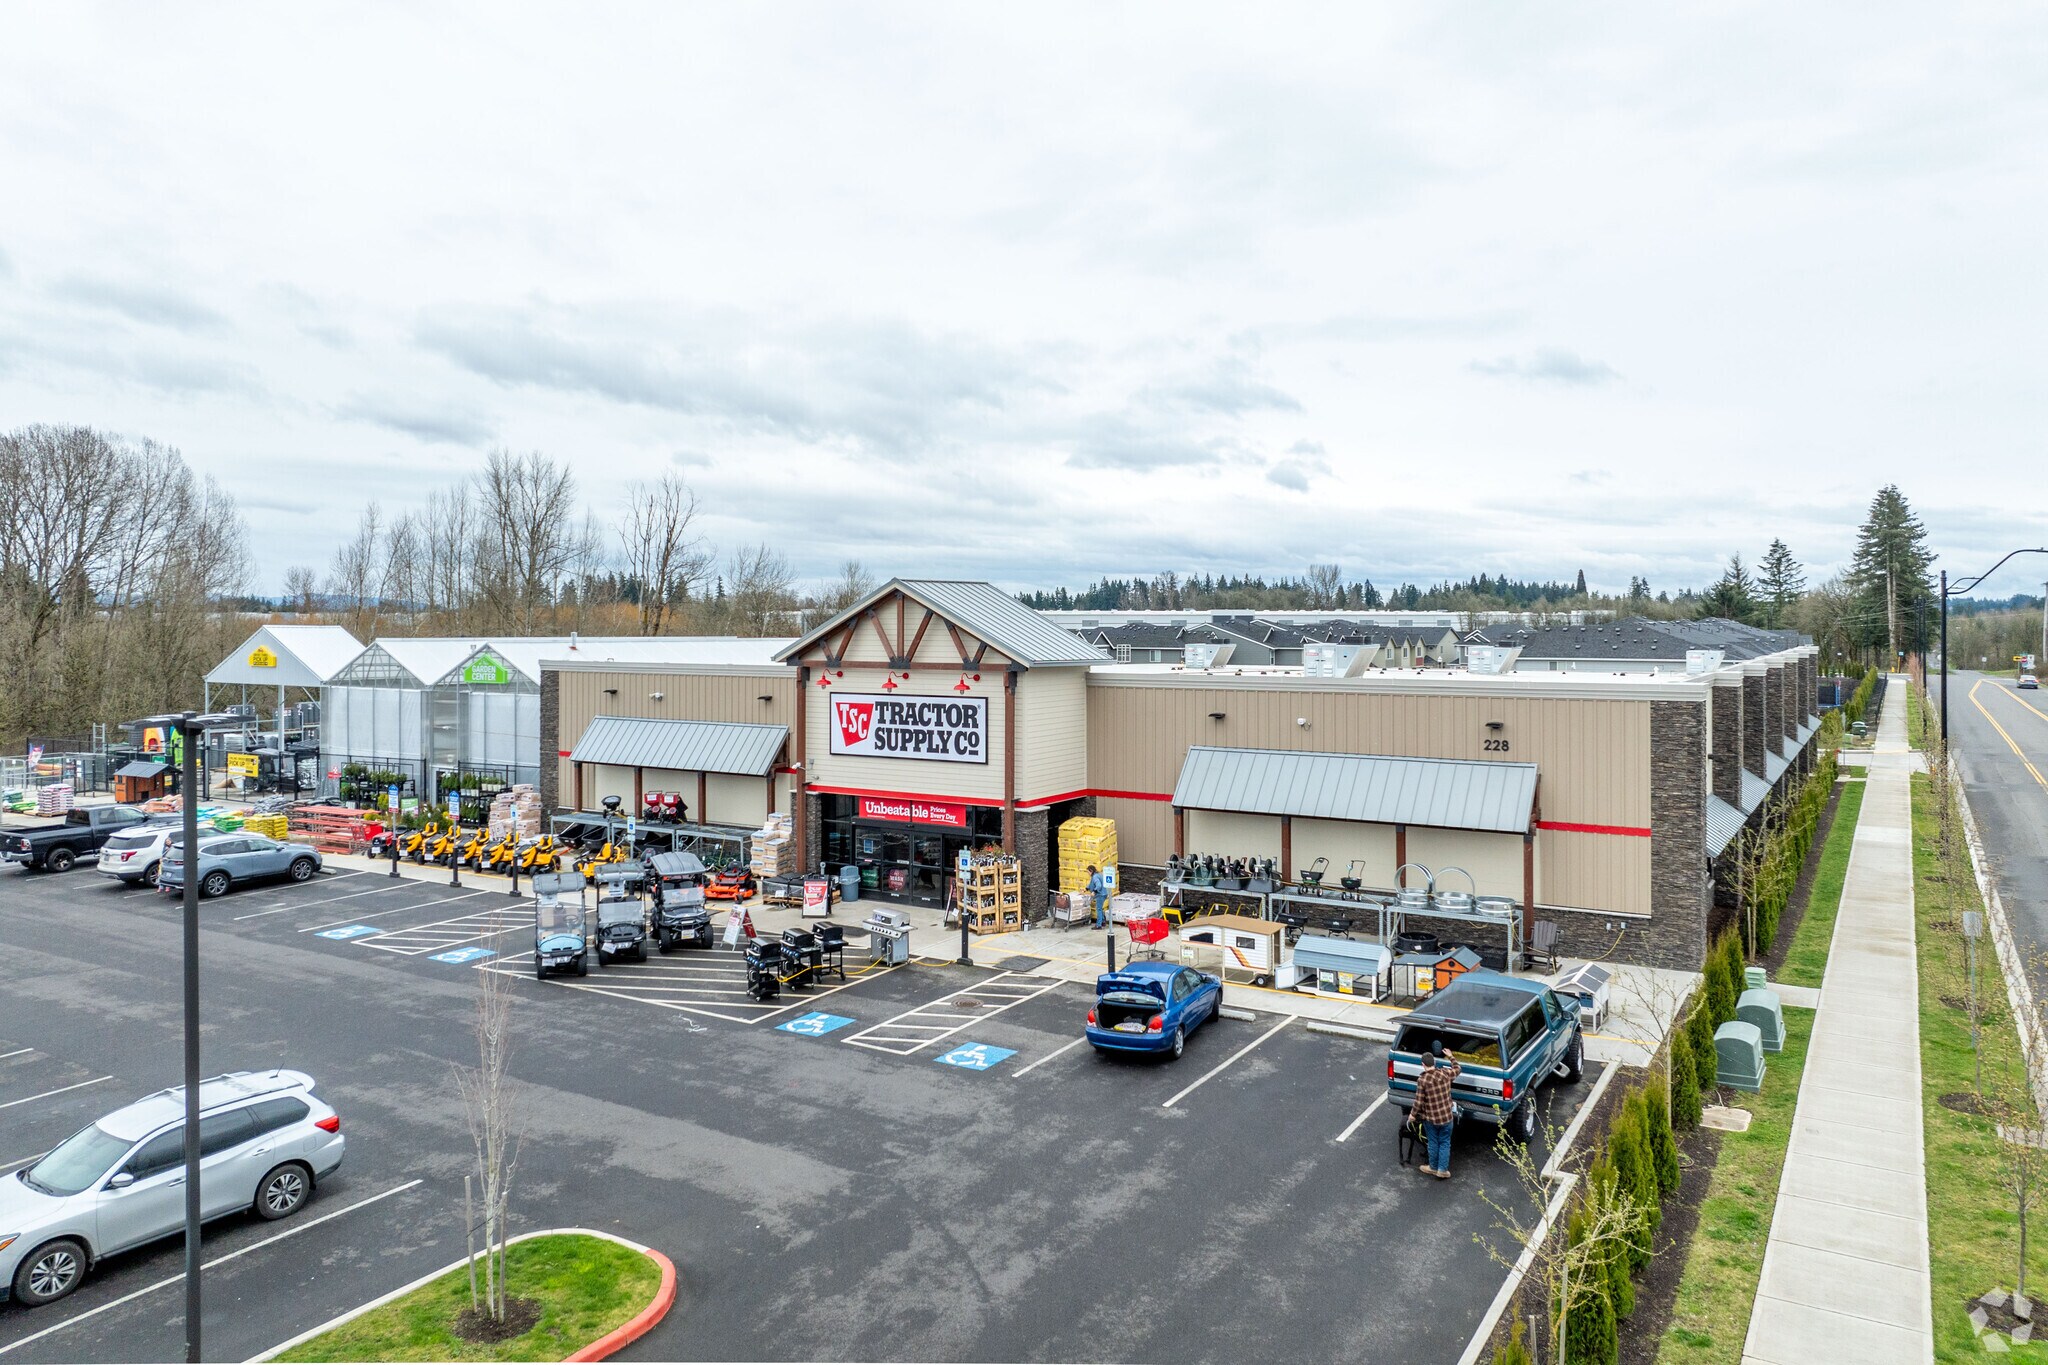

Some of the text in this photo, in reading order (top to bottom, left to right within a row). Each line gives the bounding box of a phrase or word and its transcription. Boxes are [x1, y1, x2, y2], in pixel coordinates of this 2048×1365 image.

[472, 665, 496, 673] GARDEN
[472, 673, 496, 681] CENTER
[874, 701, 979, 728] TRACTOR
[840, 704, 868, 738] TSC
[874, 727, 952, 754] SUPPLY
[1484, 740, 1509, 751] 228
[865, 801, 928, 818] Unbeatable
[930, 806, 946, 814] Prices
[930, 812, 956, 822] Every Day
